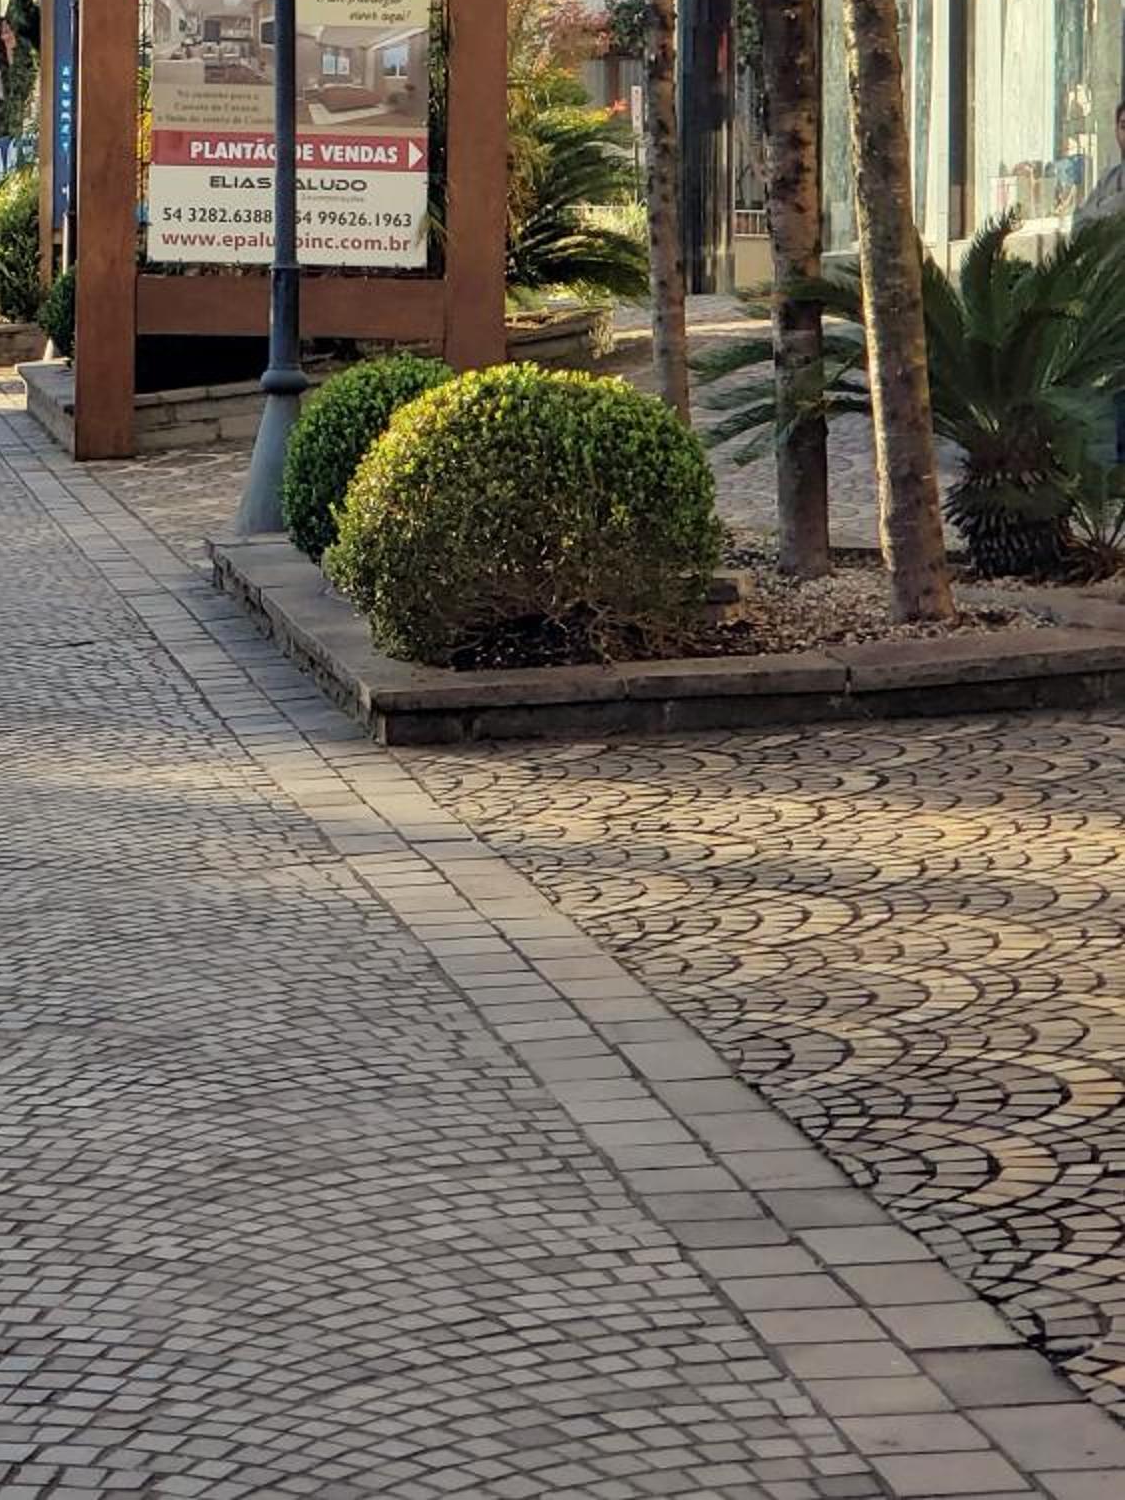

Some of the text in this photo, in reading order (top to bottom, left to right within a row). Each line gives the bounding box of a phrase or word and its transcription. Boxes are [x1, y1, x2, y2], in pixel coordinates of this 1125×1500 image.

[320, 145, 398, 163] VENDAS
[210, 176, 367, 191] ELIAS ALUDO
[163, 207, 182, 221] 54
[188, 207, 273, 223] 3282.6388
[318, 211, 412, 227] 99626.1963
[162, 232, 411, 251] www.epaluoinc.com.br
